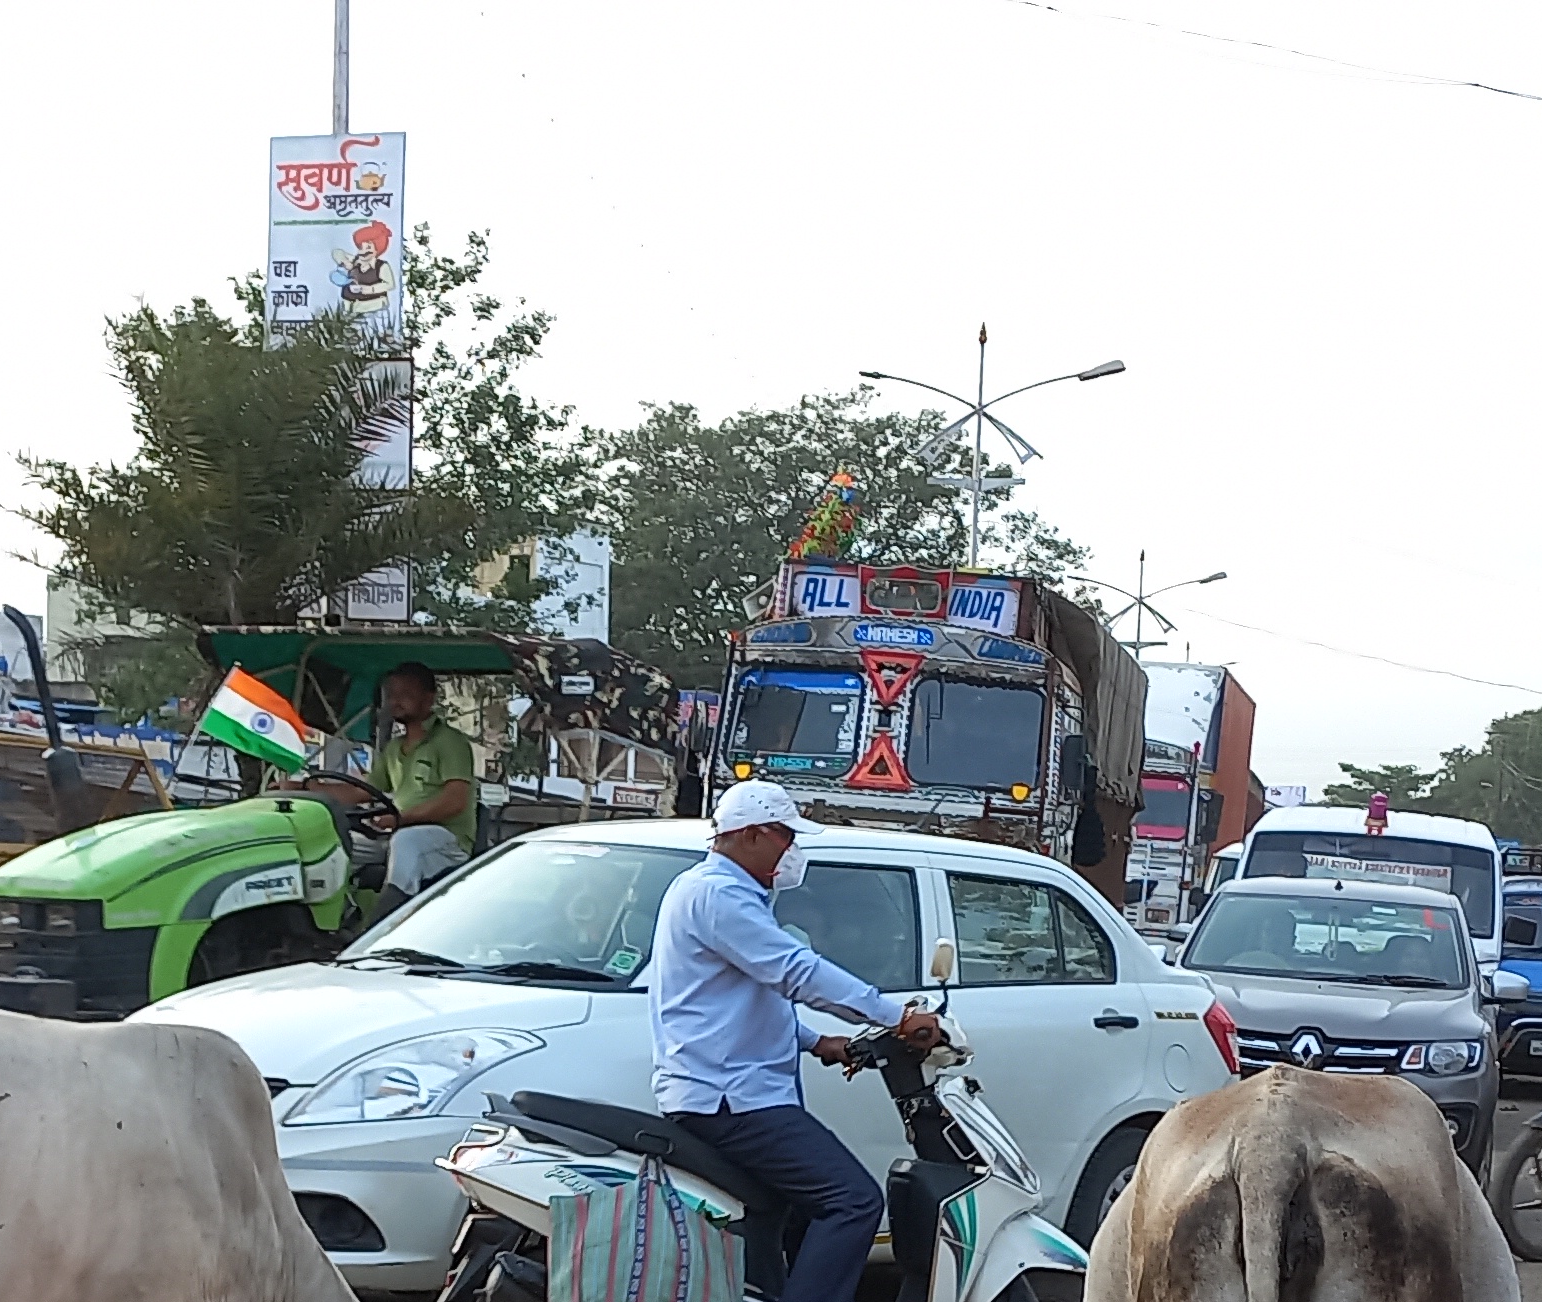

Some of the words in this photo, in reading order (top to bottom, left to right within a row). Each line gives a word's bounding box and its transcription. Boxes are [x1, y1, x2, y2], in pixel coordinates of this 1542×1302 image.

[276, 135, 380, 211] सुवर्ण
[323, 193, 393, 217] अमृततुल्य
[271, 285, 309, 308] कॉफी
[800, 577, 850, 612] ALL
[948, 587, 1005, 629] INDIA
